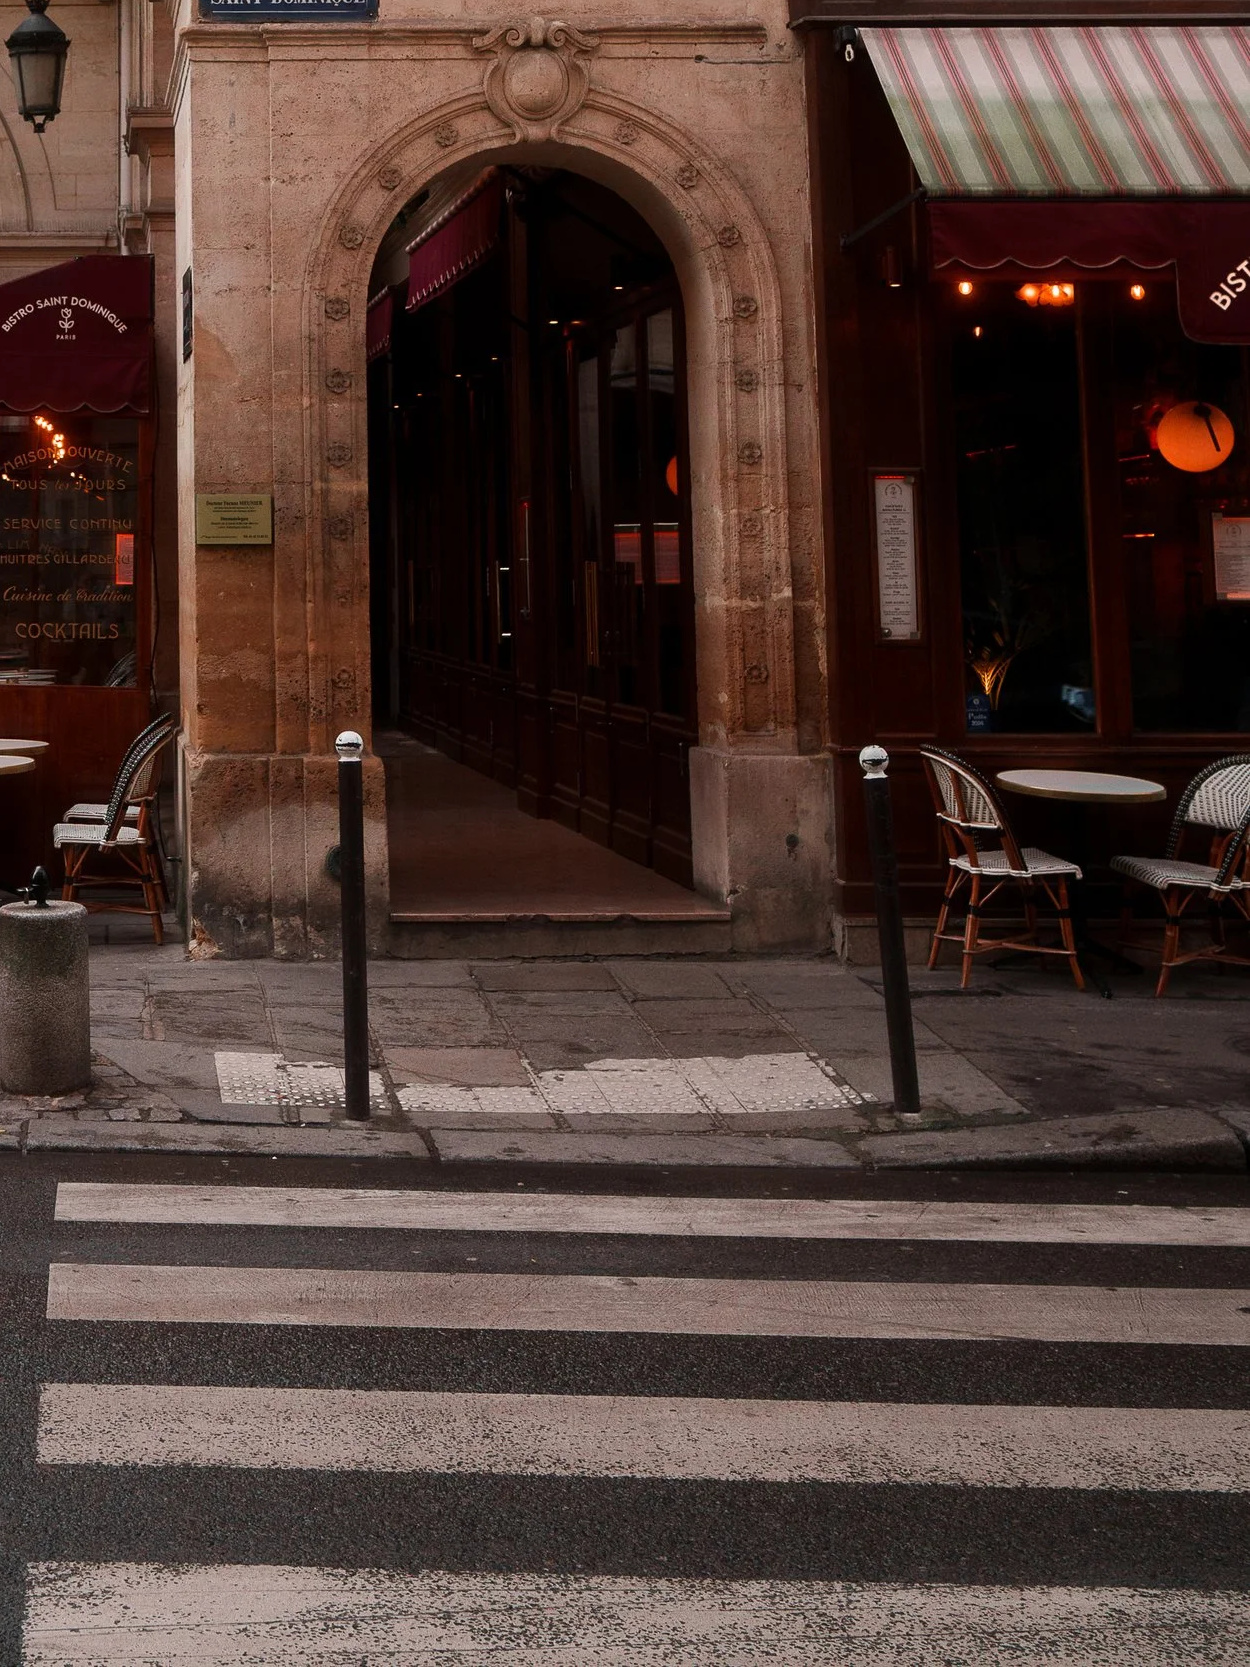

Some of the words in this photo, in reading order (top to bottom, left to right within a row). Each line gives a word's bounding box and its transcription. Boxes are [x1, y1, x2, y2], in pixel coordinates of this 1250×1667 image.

[1209, 256, 1250, 311] BIST
[1, 303, 35, 333] BISTRO
[36, 295, 68, 309] SAINT
[70, 296, 128, 334] DOMINIQUE
[3, 447, 59, 473] MAISON
[67, 445, 133, 473] OUVERTE
[10, 479, 48, 490] TOUS
[74, 478, 126, 491] JOURS
[3, 518, 62, 530] SERVICE
[70, 518, 132, 530] CONTINU
[0, 553, 50, 565] HUITRES
[2, 585, 53, 603] Cuisine
[57, 588, 72, 603] de
[15, 622, 119, 640] COCKTAILS
